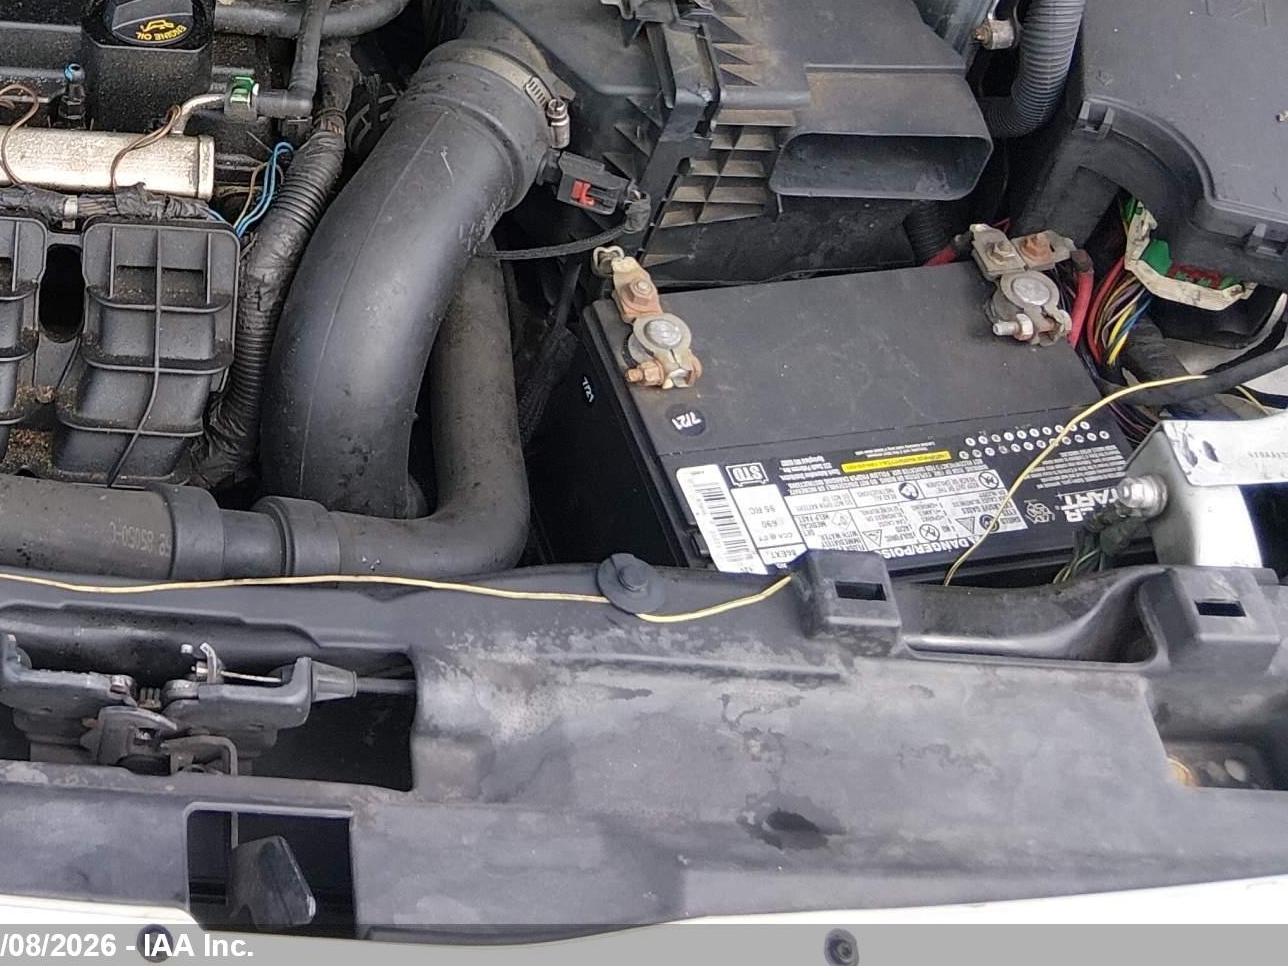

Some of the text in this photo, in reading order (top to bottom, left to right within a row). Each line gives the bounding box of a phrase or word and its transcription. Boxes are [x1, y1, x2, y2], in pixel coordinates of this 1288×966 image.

[135, 32, 153, 41] OIL
[671, 411, 702, 431] 7/21
[1060, 488, 1120, 511] TART
